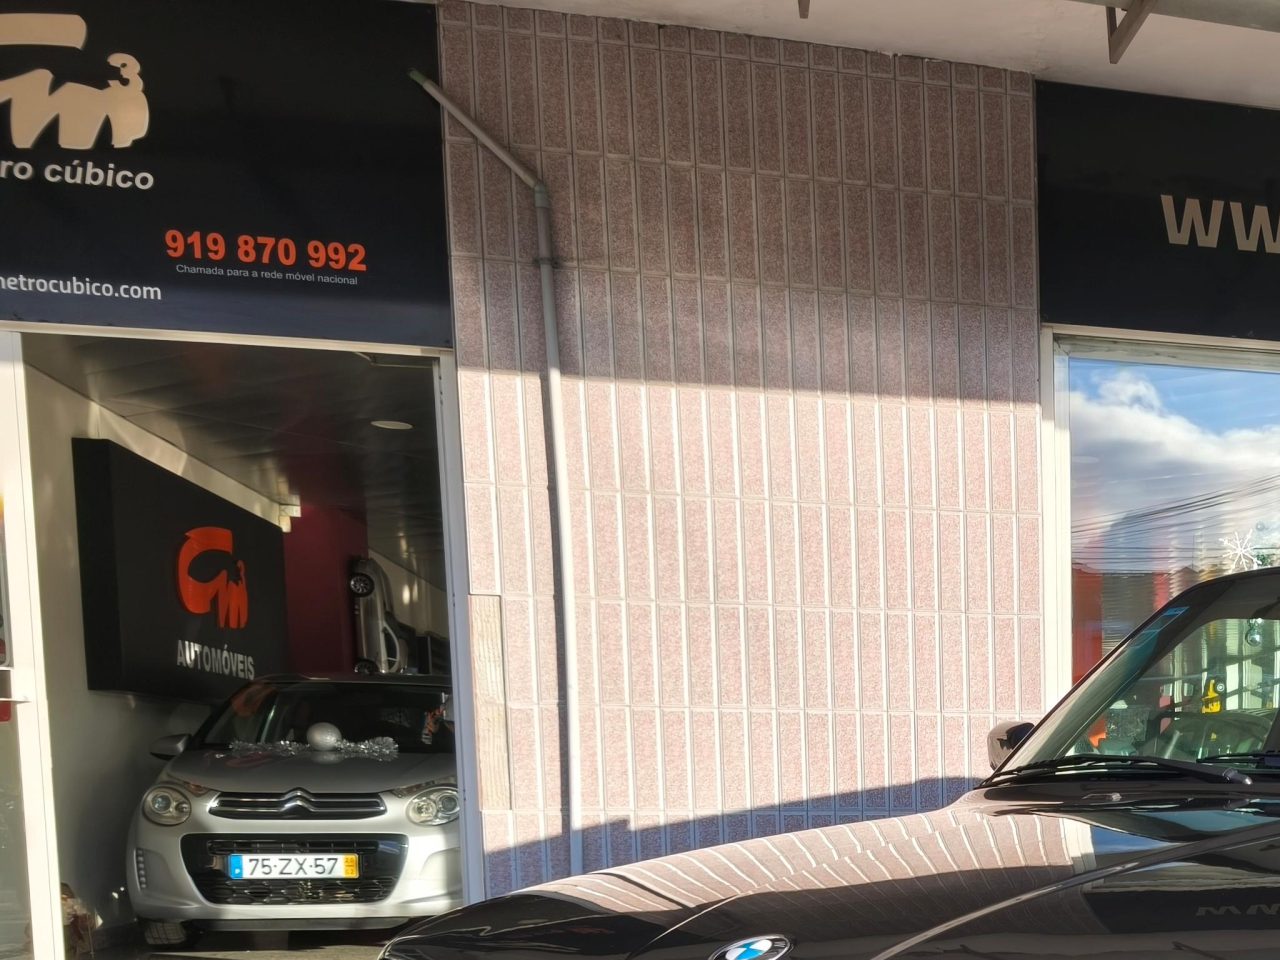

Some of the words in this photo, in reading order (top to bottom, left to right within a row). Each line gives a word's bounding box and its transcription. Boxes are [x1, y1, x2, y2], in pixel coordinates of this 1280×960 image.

[44, 160, 154, 190] cúbico
[165, 230, 226, 261] 919
[237, 234, 297, 266] 870
[307, 240, 367, 272] 992
[176, 264, 225, 276] Chamada
[226, 269, 249, 278] para
[260, 270, 283, 279] rede
[286, 271, 315, 282] móvel
[317, 274, 358, 285] nacional
[177, 639, 255, 680] AUTOMÓVEIS
